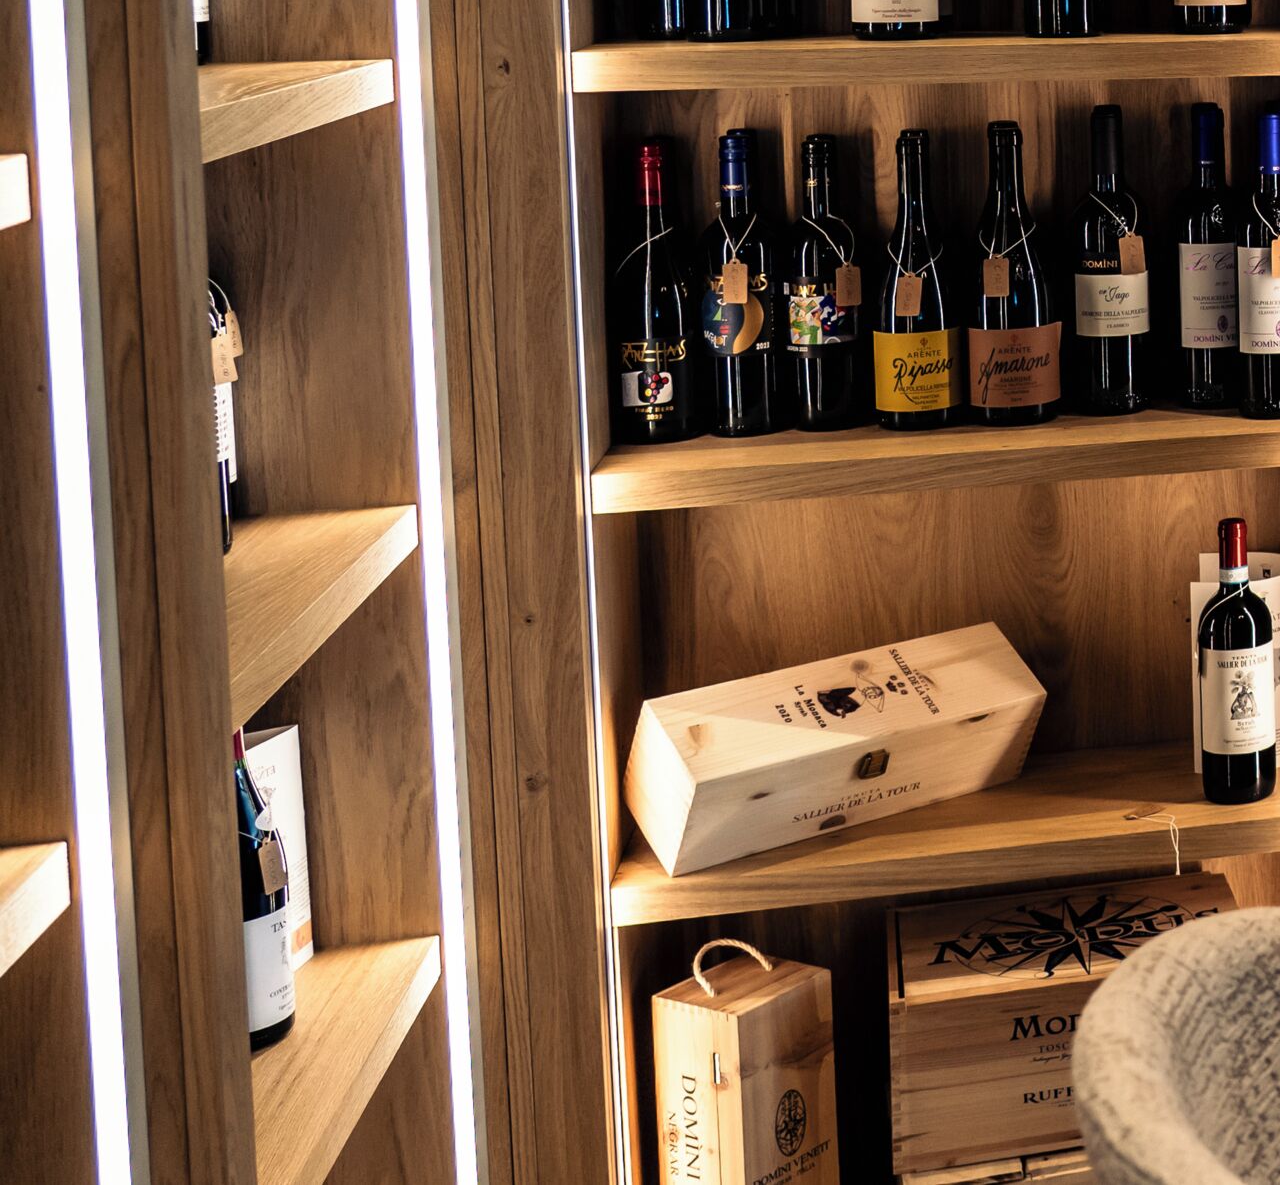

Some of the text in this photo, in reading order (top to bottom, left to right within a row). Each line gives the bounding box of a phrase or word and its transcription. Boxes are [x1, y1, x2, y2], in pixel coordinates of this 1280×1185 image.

[1185, 252, 1207, 271] La
[893, 357, 954, 394] Ripasso
[978, 348, 1050, 404] Amarone
[792, 781, 921, 823] SALLIER DE LA TOUR
[1038, 1042, 1069, 1054] TOSC
[681, 1074, 701, 1180] DOMÌNI
[793, 1139, 831, 1168] VENETI
